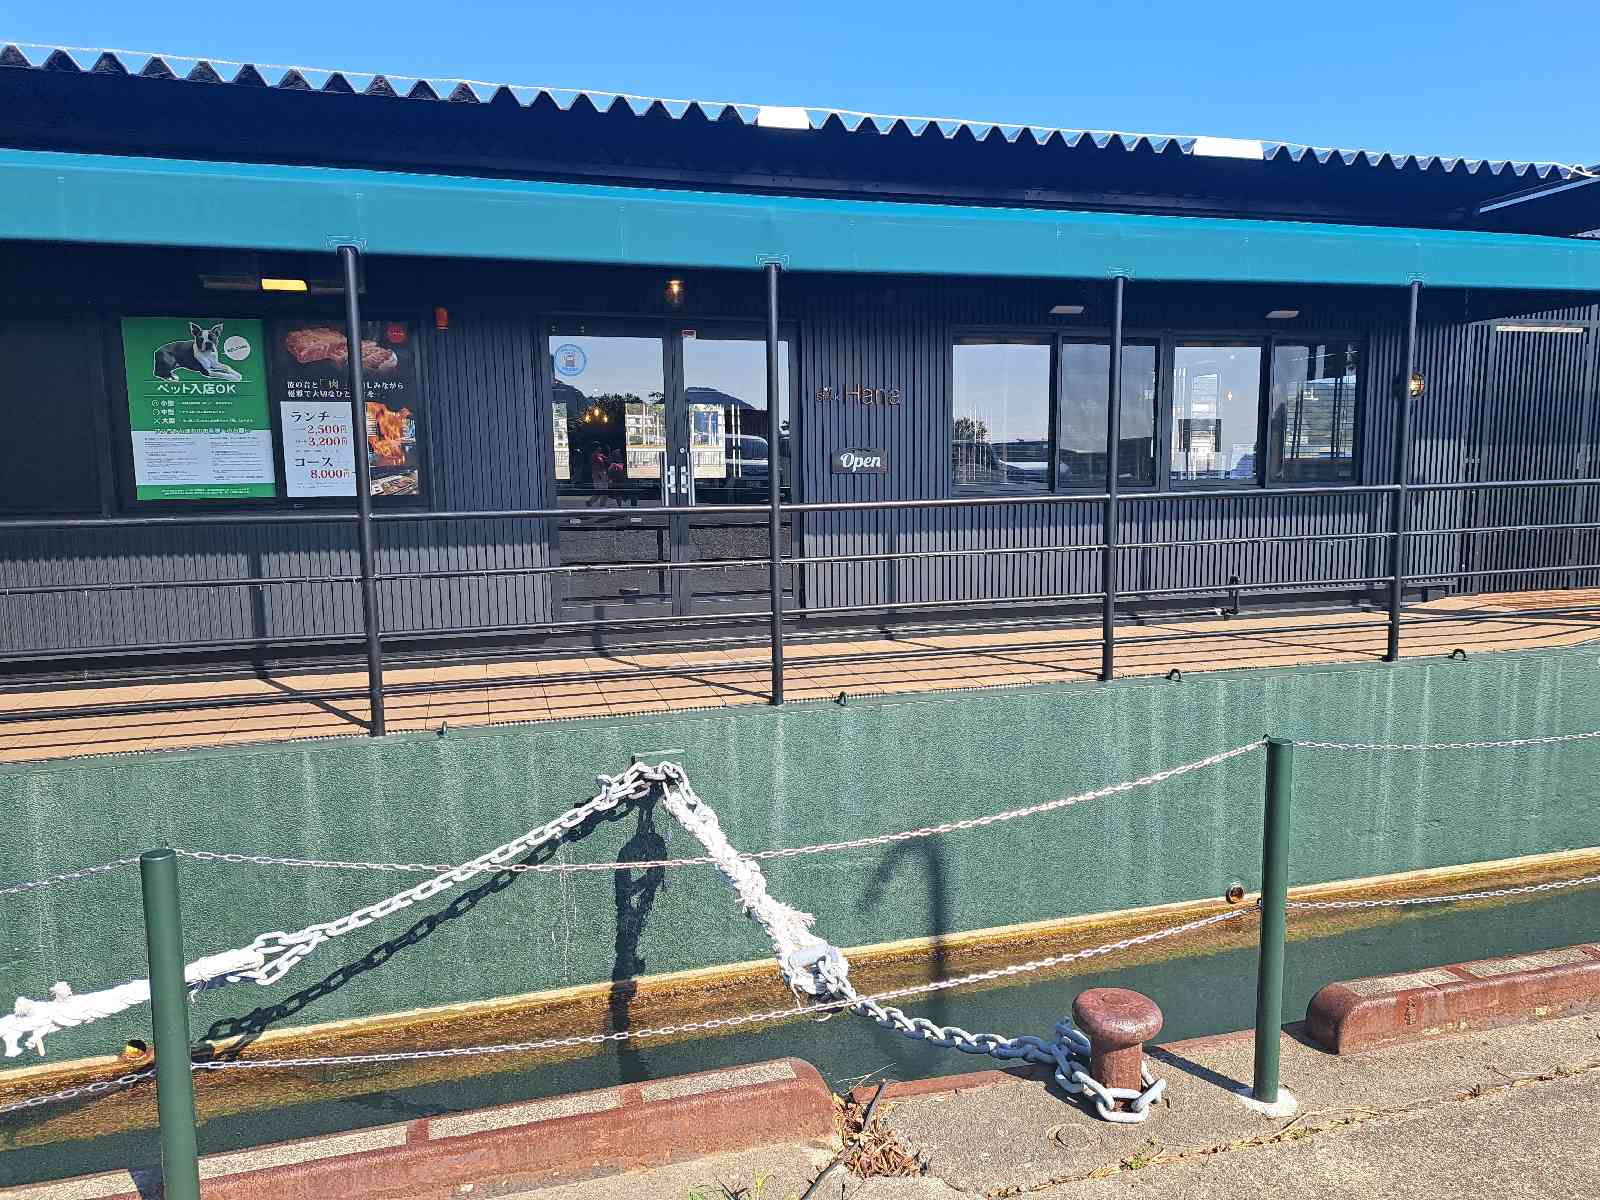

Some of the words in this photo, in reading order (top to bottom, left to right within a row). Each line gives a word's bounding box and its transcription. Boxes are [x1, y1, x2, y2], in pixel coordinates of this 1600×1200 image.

[158, 383, 236, 395] ペット入店OK
[290, 410, 331, 423] ランチ
[295, 456, 334, 467] コース
[840, 452, 880, 472] Open
